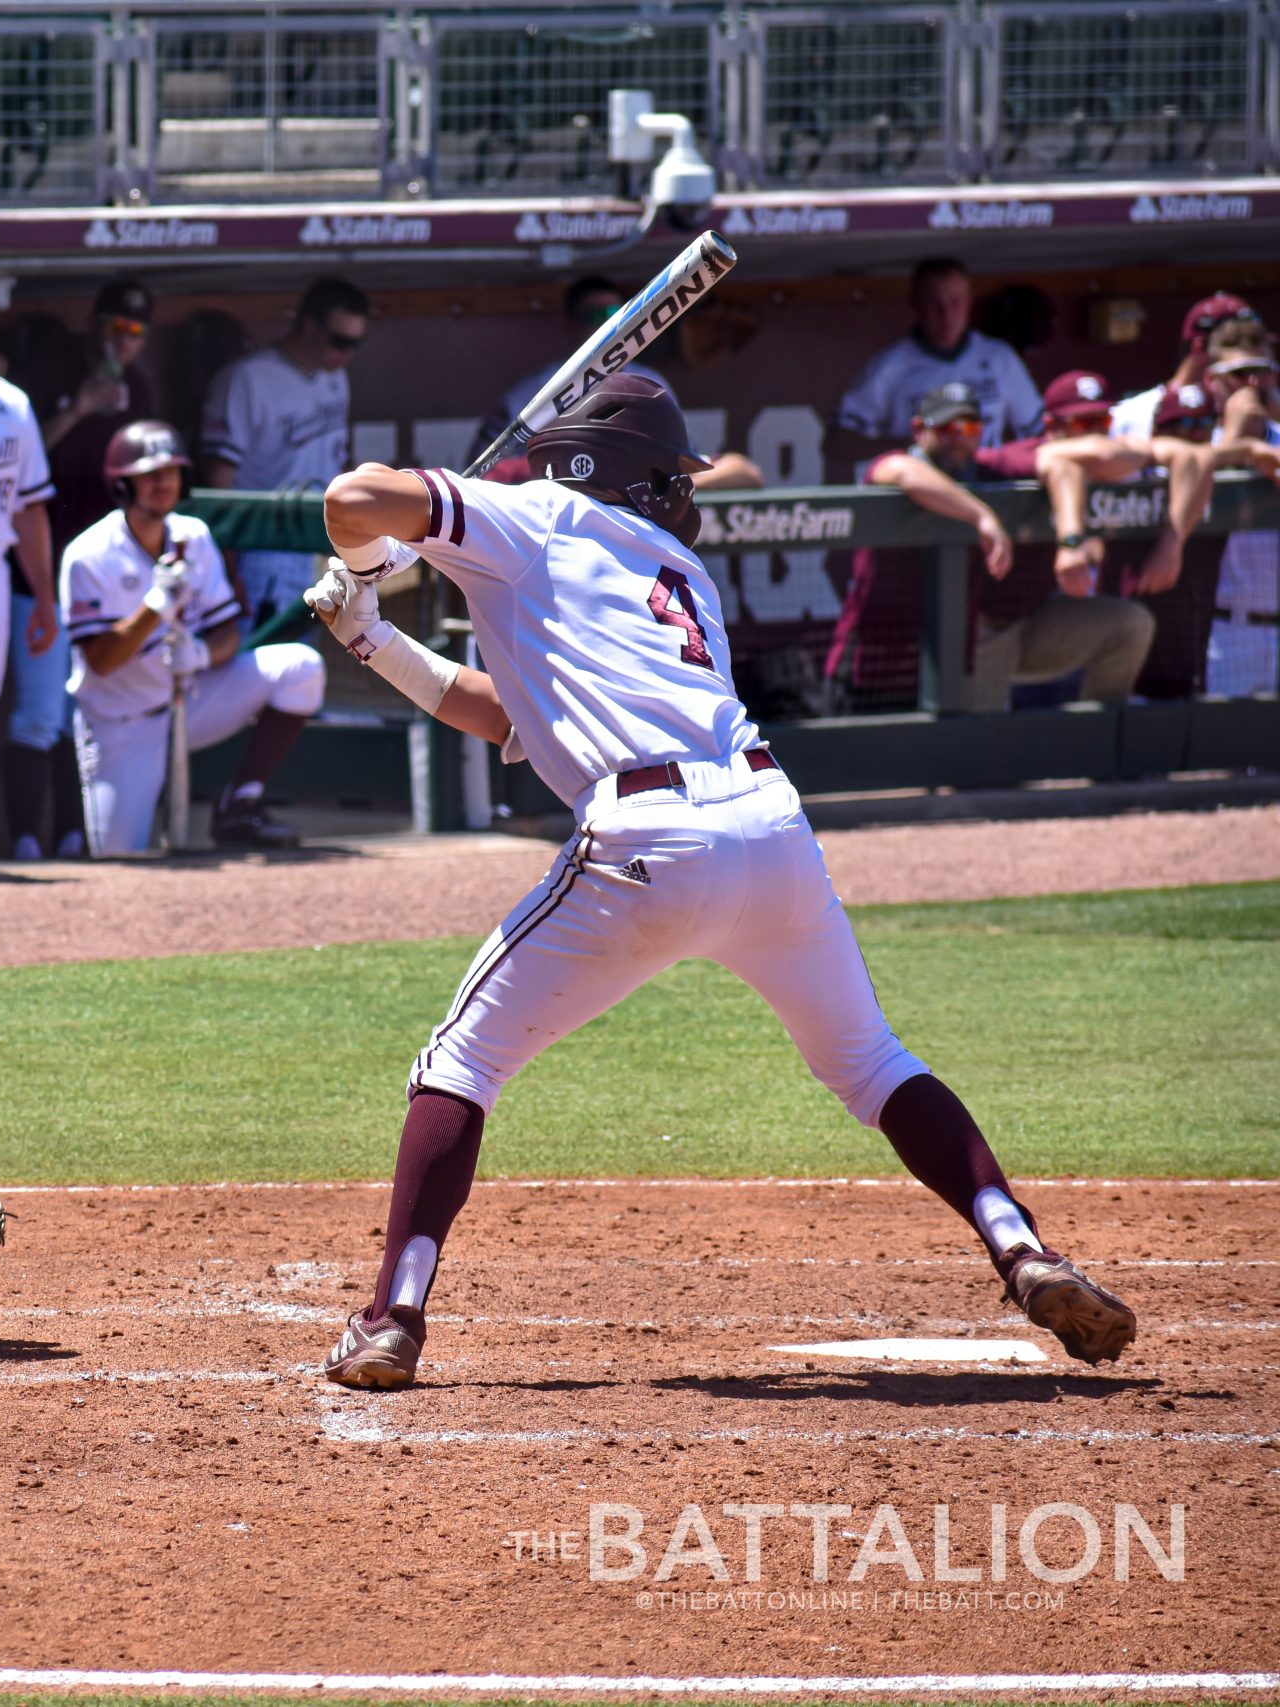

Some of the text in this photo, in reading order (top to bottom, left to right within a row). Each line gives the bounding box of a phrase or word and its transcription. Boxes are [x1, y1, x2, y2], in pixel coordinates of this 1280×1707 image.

[552, 271, 706, 416] EASTON
[574, 457, 592, 476] SEC
[647, 564, 715, 672] 4
[619, 869, 651, 885] adidas
